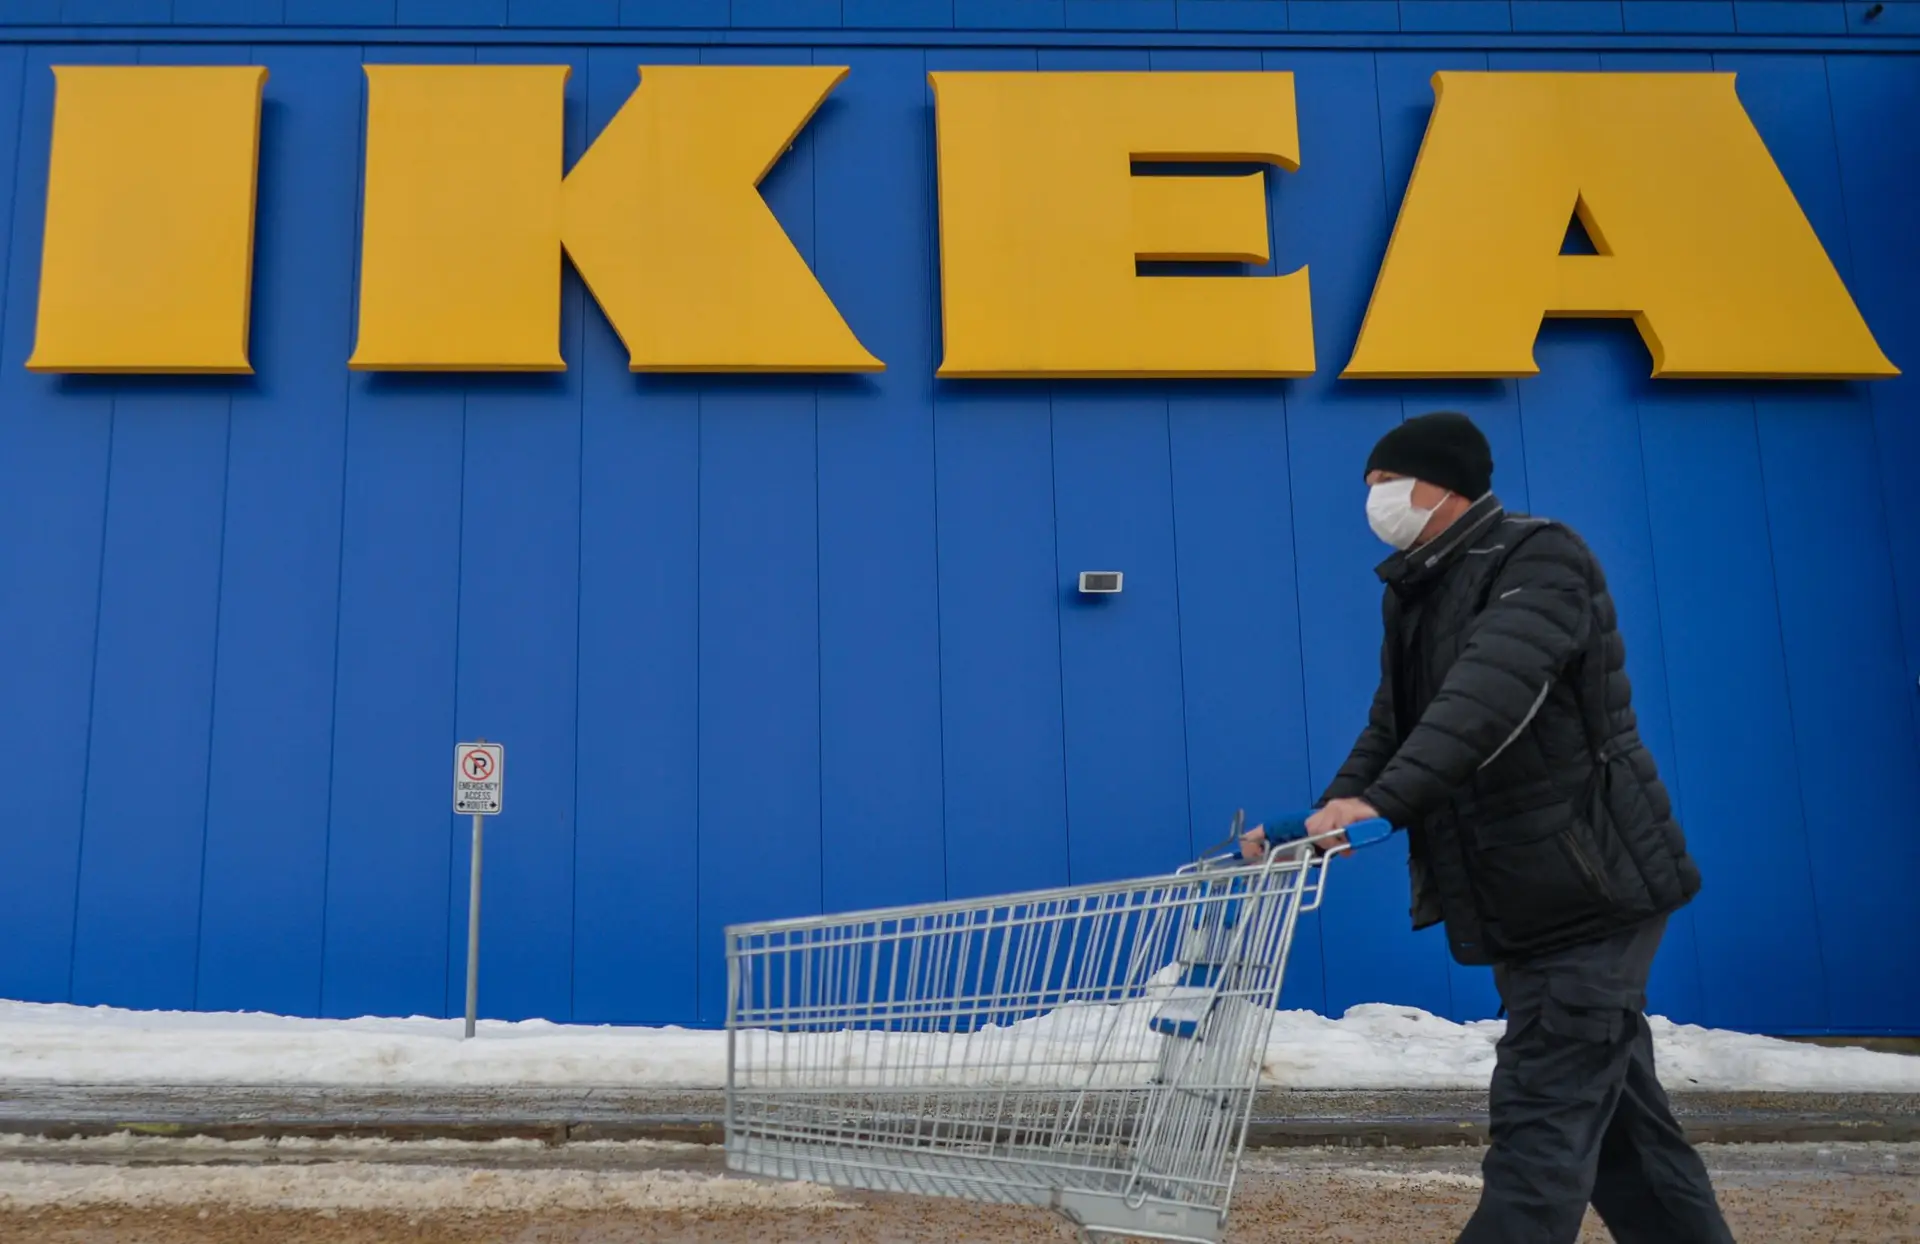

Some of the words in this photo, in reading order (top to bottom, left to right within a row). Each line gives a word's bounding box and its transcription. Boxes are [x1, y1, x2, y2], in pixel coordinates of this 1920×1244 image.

[25, 64, 1902, 380] IKEA
[459, 782, 498, 791] EMERGENCY
[465, 791, 491, 800] ACCESS
[466, 801, 489, 810] ROUTE
